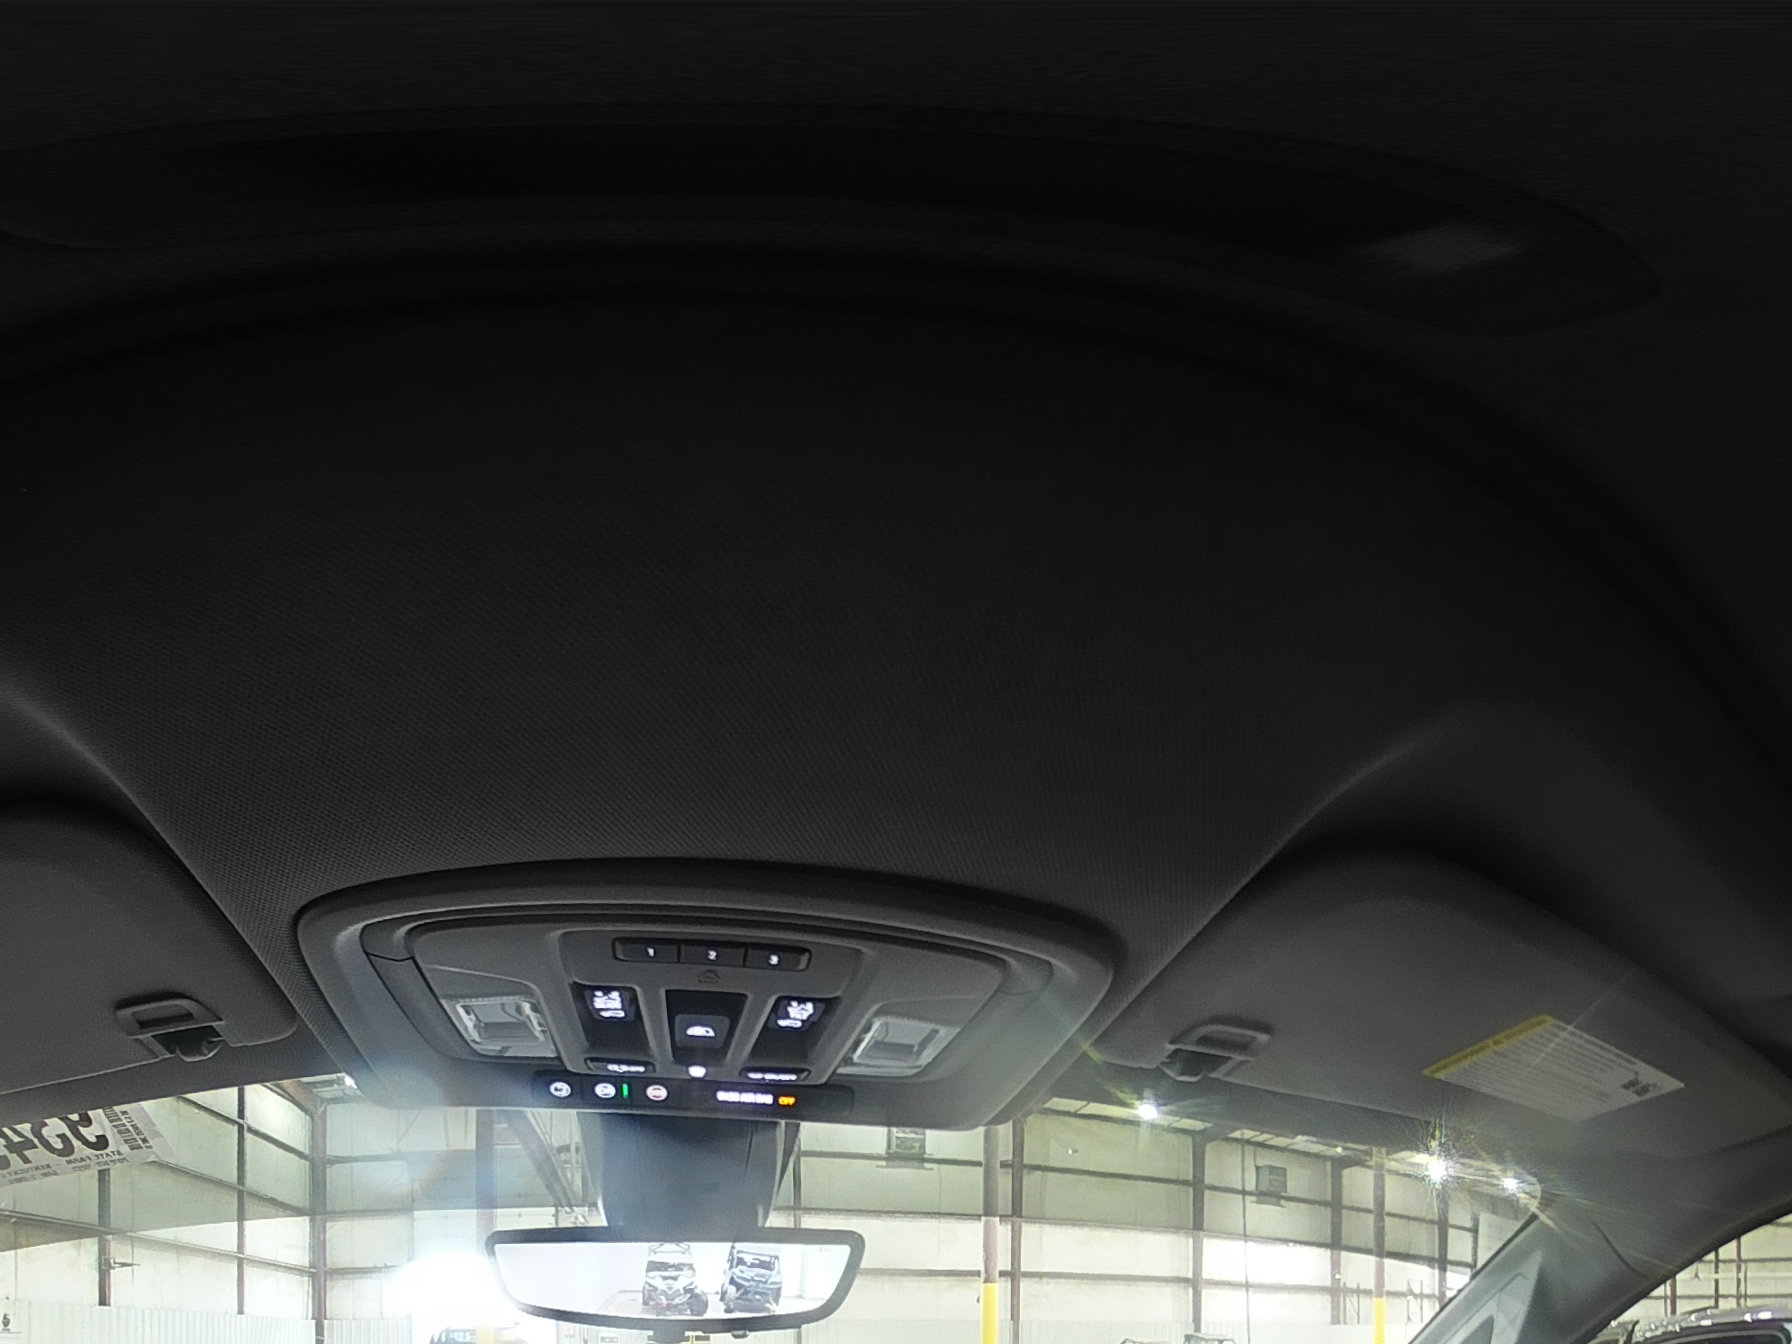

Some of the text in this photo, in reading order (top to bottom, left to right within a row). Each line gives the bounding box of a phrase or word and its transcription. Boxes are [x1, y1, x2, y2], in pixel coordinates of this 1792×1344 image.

[647, 948, 655, 957] 1
[708, 950, 717, 960] 2
[768, 954, 779, 965] 3
